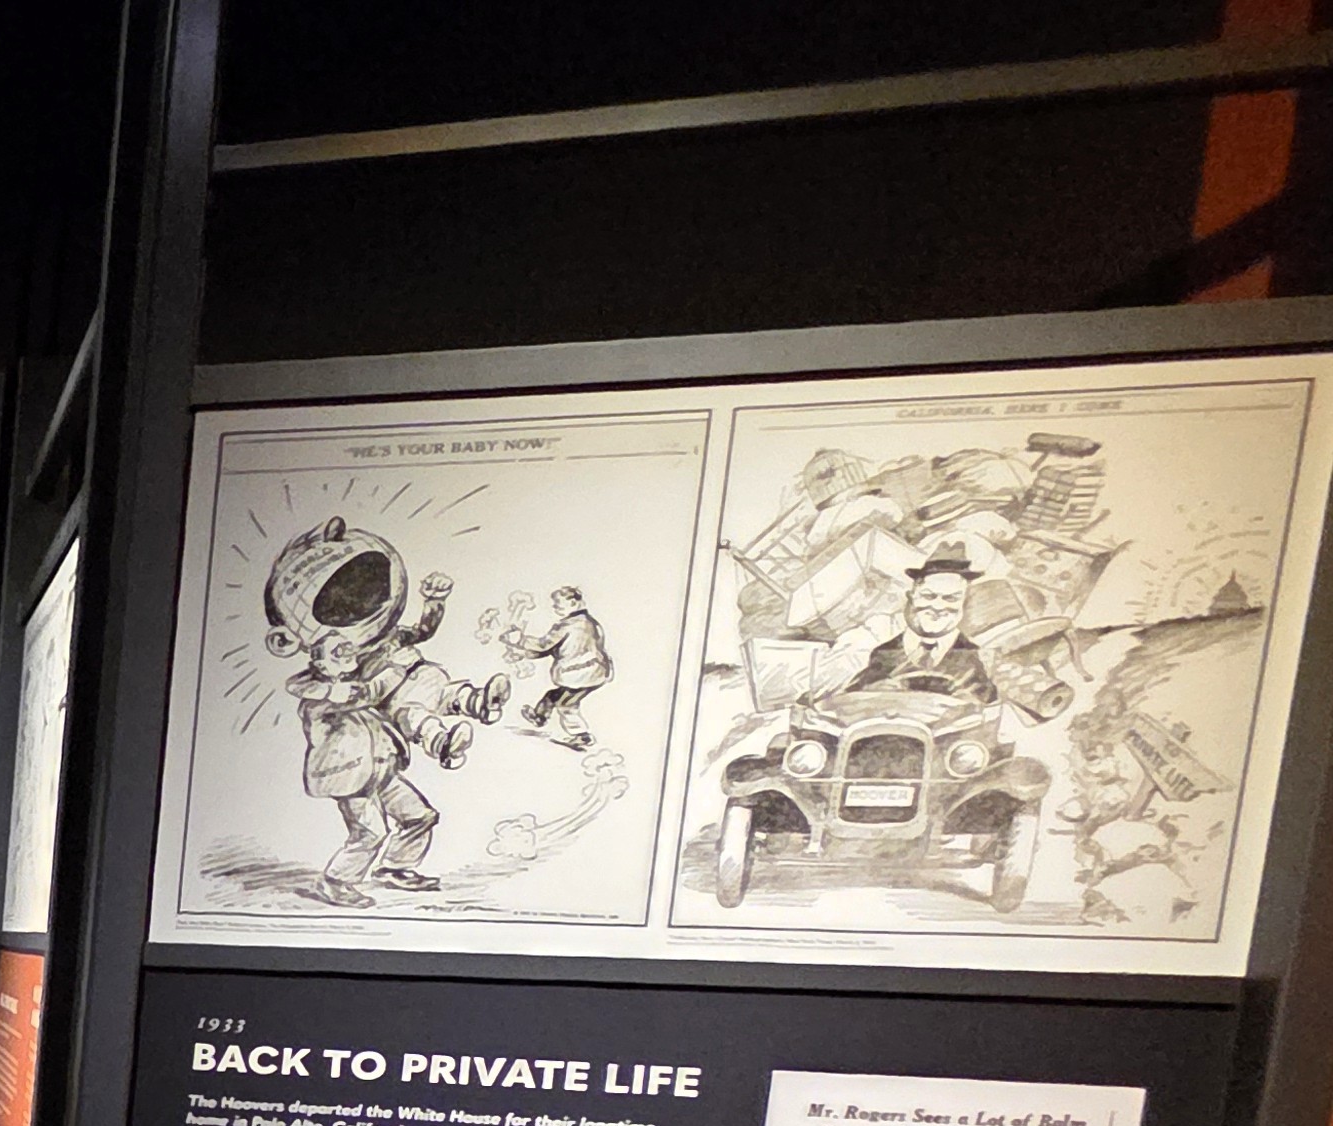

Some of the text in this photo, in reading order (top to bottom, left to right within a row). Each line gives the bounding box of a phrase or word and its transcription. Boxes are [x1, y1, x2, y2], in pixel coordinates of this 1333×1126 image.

[397, 443, 445, 456] YOUR
[451, 440, 498, 453] BABY
[291, 546, 333, 573] WORLD
[1165, 768, 1194, 801] LIFE
[198, 1017, 246, 1033] 1933
[192, 1042, 702, 1098] BACK TO PRIVATE LIFE
[186, 1112, 229, 1126] home
[233, 1116, 248, 1126] in
[189, 1094, 217, 1108] The
[221, 1097, 284, 1112] Hoovers
[289, 1100, 363, 1116] departed
[367, 1105, 393, 1118] the
[398, 1106, 445, 1122] White
[449, 1110, 501, 1125] House
[808, 1104, 837, 1118] Mr.
[844, 1106, 906, 1122] Rogers
[912, 1109, 951, 1124] Sees
[958, 1116, 968, 1125] a
[975, 1111, 1005, 1126] Lot
[1011, 1114, 1033, 1126] of
